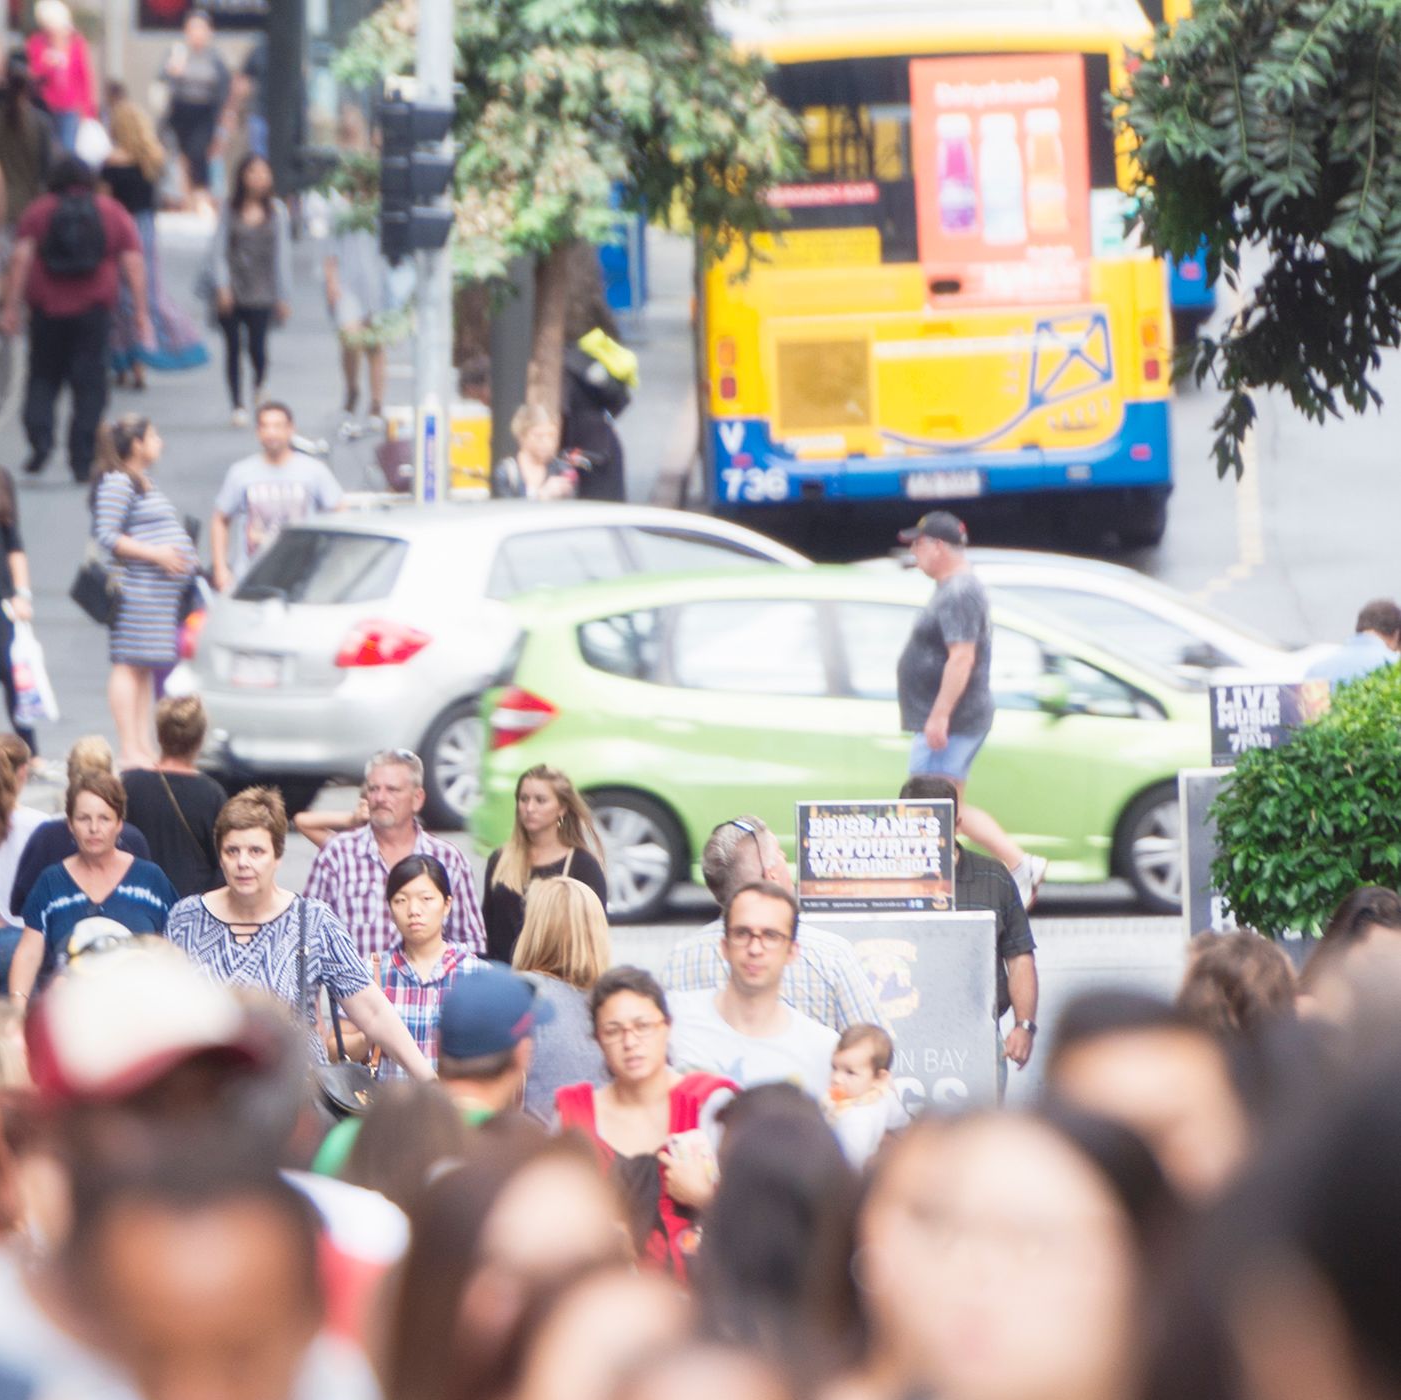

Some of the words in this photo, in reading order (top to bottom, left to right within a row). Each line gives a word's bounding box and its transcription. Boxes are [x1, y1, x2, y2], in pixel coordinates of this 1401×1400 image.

[718, 421, 746, 455] V
[720, 466, 789, 502] 736
[1216, 686, 1280, 709] LIVE
[1217, 709, 1280, 728] MUSIC
[808, 815, 941, 837] BRISBANE'S
[808, 837, 941, 858] FAVOURITE
[924, 1048, 969, 1074] BAY
